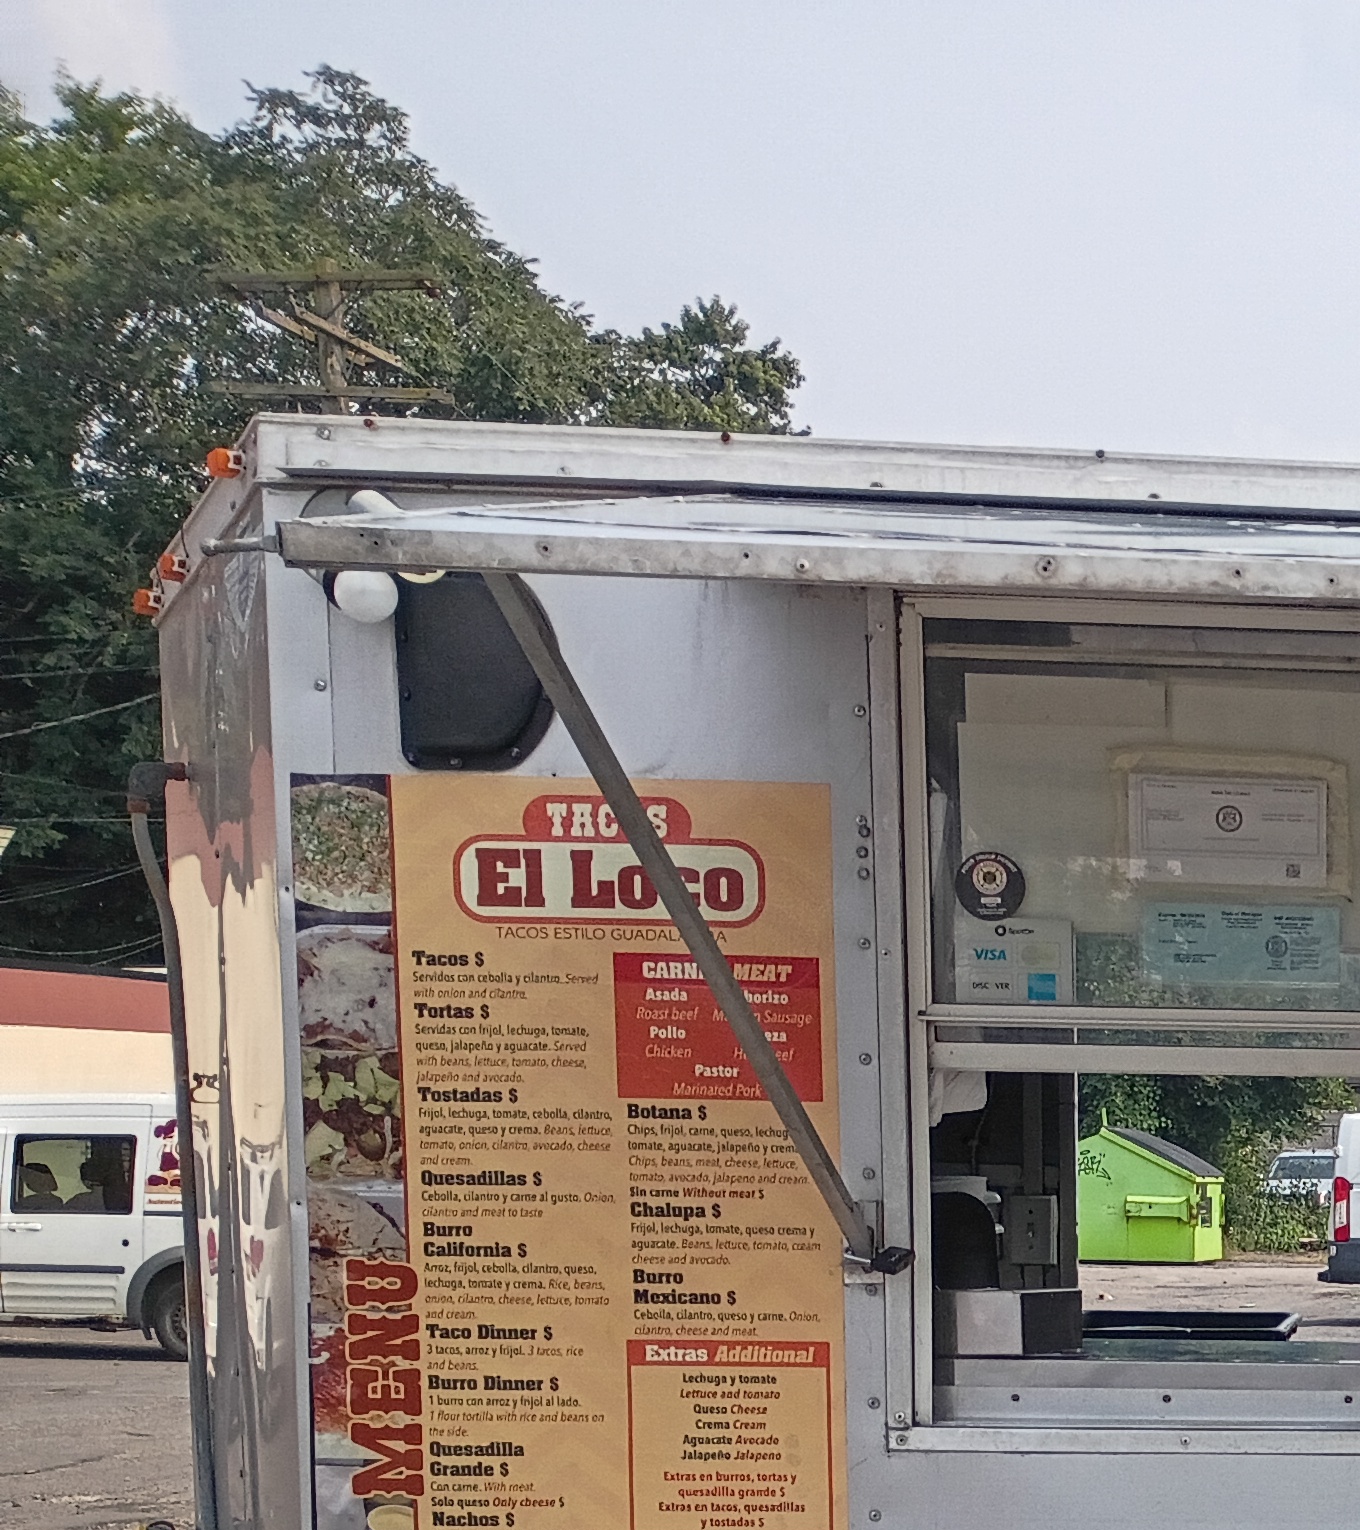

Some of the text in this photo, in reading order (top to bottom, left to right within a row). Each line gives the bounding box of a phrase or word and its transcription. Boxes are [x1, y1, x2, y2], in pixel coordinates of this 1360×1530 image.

[547, 803, 667, 838] TACS
[475, 848, 545, 908] El
[497, 927, 727, 943] TACOS ESTILO GUADALA
[412, 951, 469, 966] Tacos
[973, 948, 1006, 960] VISA
[643, 962, 792, 981] CARN MEAT
[646, 988, 789, 1004] Asada horizo
[414, 1003, 474, 1018] Tortas
[637, 1007, 669, 1020] Roast
[671, 1007, 699, 1020] beef
[764, 1011, 813, 1028] Sausage
[650, 1026, 686, 1039] Pollo
[645, 1045, 692, 1058] Chicken
[695, 1065, 739, 1077] Pastor
[417, 1088, 502, 1102] Tostadas
[673, 1083, 763, 1097] Marinated Pork
[627, 1104, 692, 1119] Botana
[421, 1171, 527, 1186] Quesadillas
[630, 1203, 706, 1221] Chalupa
[423, 1223, 472, 1236] Burro
[424, 1242, 512, 1257] California
[633, 1269, 683, 1284] Burro
[634, 1290, 721, 1304] Mexicano
[426, 1324, 537, 1340] Taco Dinner
[645, 1345, 815, 1363] Extras Additional
[345, 1257, 424, 1499] MENU
[428, 1376, 543, 1390] Burro Dinner
[682, 1373, 777, 1386] Lechuga y tomate
[680, 1389, 781, 1399] Lettuce and tomato
[694, 1404, 767, 1414] Queso Cheese
[696, 1419, 766, 1429] Crema Cream
[683, 1435, 779, 1447] Aguacate Avocado
[430, 1442, 524, 1457] Quesadilla
[681, 1451, 731, 1462] Jalapeño
[430, 1462, 494, 1476] Grande
[664, 1471, 696, 1481] Extras
[716, 1472, 754, 1485] burros,
[757, 1472, 787, 1482] tortas
[791, 1475, 797, 1485] y
[678, 1487, 776, 1499] quesadilla grande
[431, 1497, 556, 1509] Solo queso Only cheese
[659, 1502, 692, 1511] Extras
[711, 1502, 741, 1515] tacos,
[744, 1503, 805, 1515] quesadillas
[432, 1512, 500, 1526] Nachos
[701, 1518, 755, 1529] y tostadas
